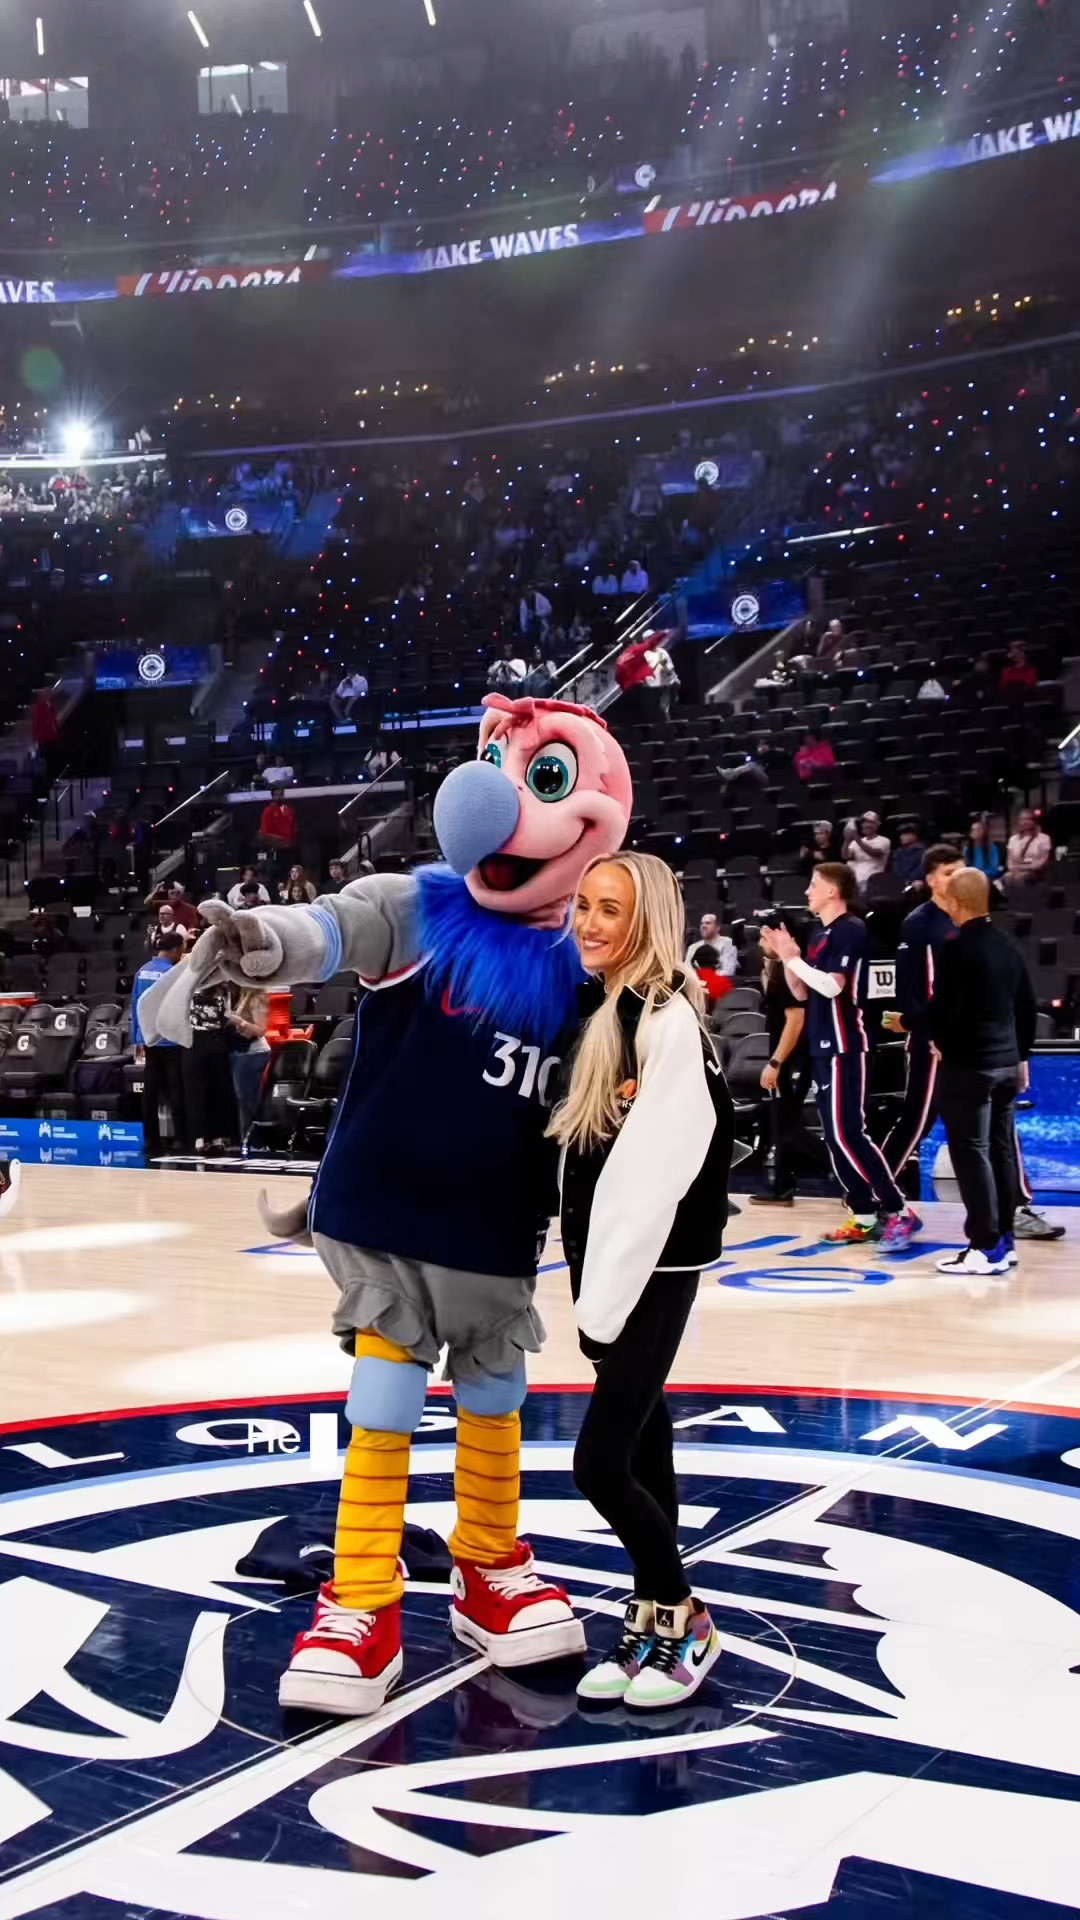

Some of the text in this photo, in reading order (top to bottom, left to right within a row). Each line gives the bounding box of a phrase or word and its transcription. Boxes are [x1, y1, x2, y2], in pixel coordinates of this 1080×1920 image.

[489, 223, 580, 260] WAVES
[55, 1013, 67, 1031] G
[17, 1035, 29, 1051] G
[95, 1033, 108, 1049] G
